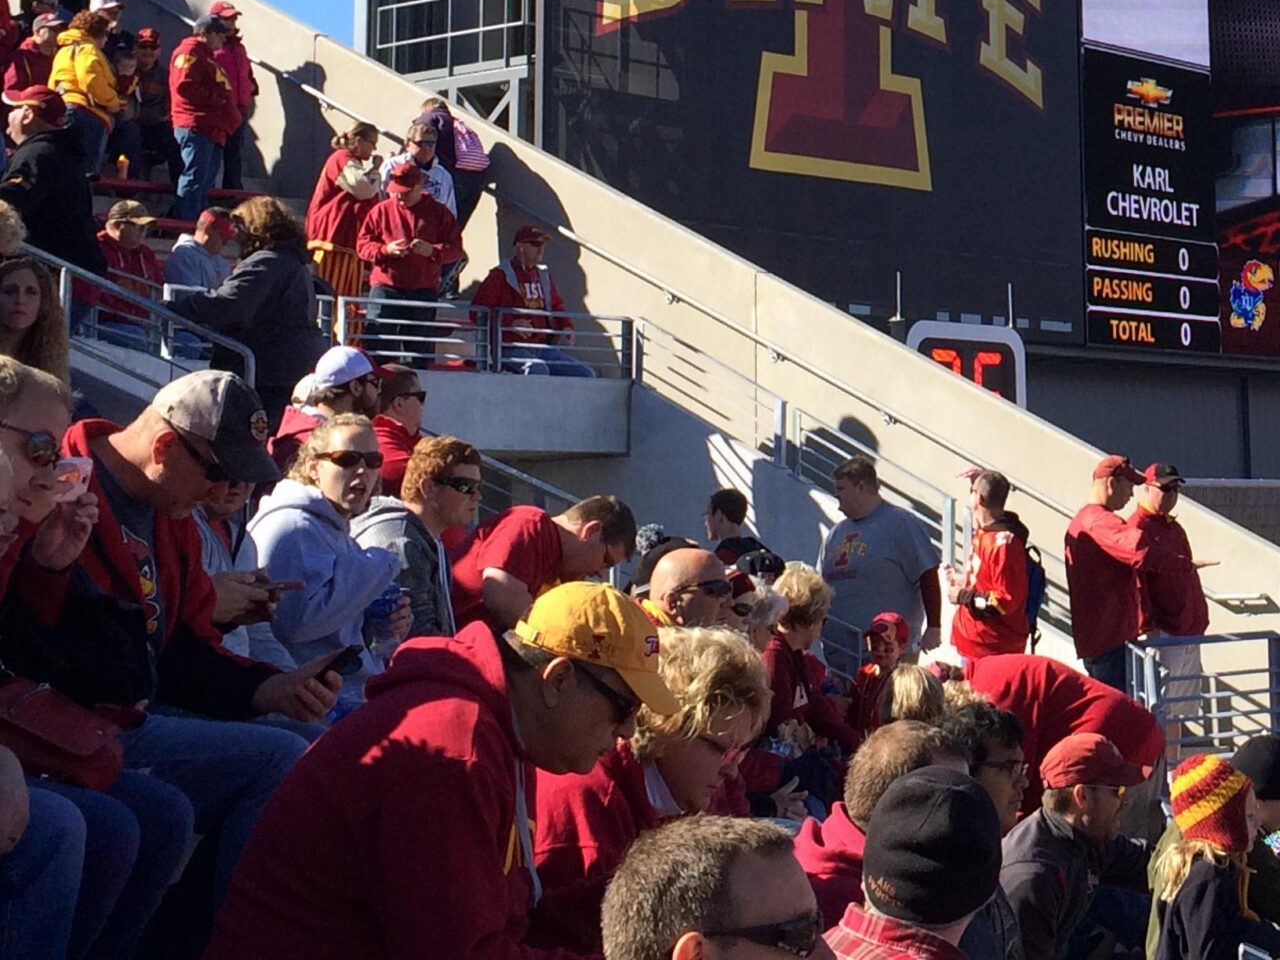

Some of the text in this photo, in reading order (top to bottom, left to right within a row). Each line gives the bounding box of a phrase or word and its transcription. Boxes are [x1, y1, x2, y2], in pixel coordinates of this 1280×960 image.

[1113, 103, 1184, 140] PREMIER
[1114, 128, 1186, 152] CHEVY DEALERS
[1132, 163, 1175, 193] KARL
[1106, 190, 1200, 228] CHEVROLET
[1091, 237, 1189, 272] RUSHING 0
[1093, 276, 1190, 310] PASSING 0
[1110, 319, 1191, 347] TOTAL 0
